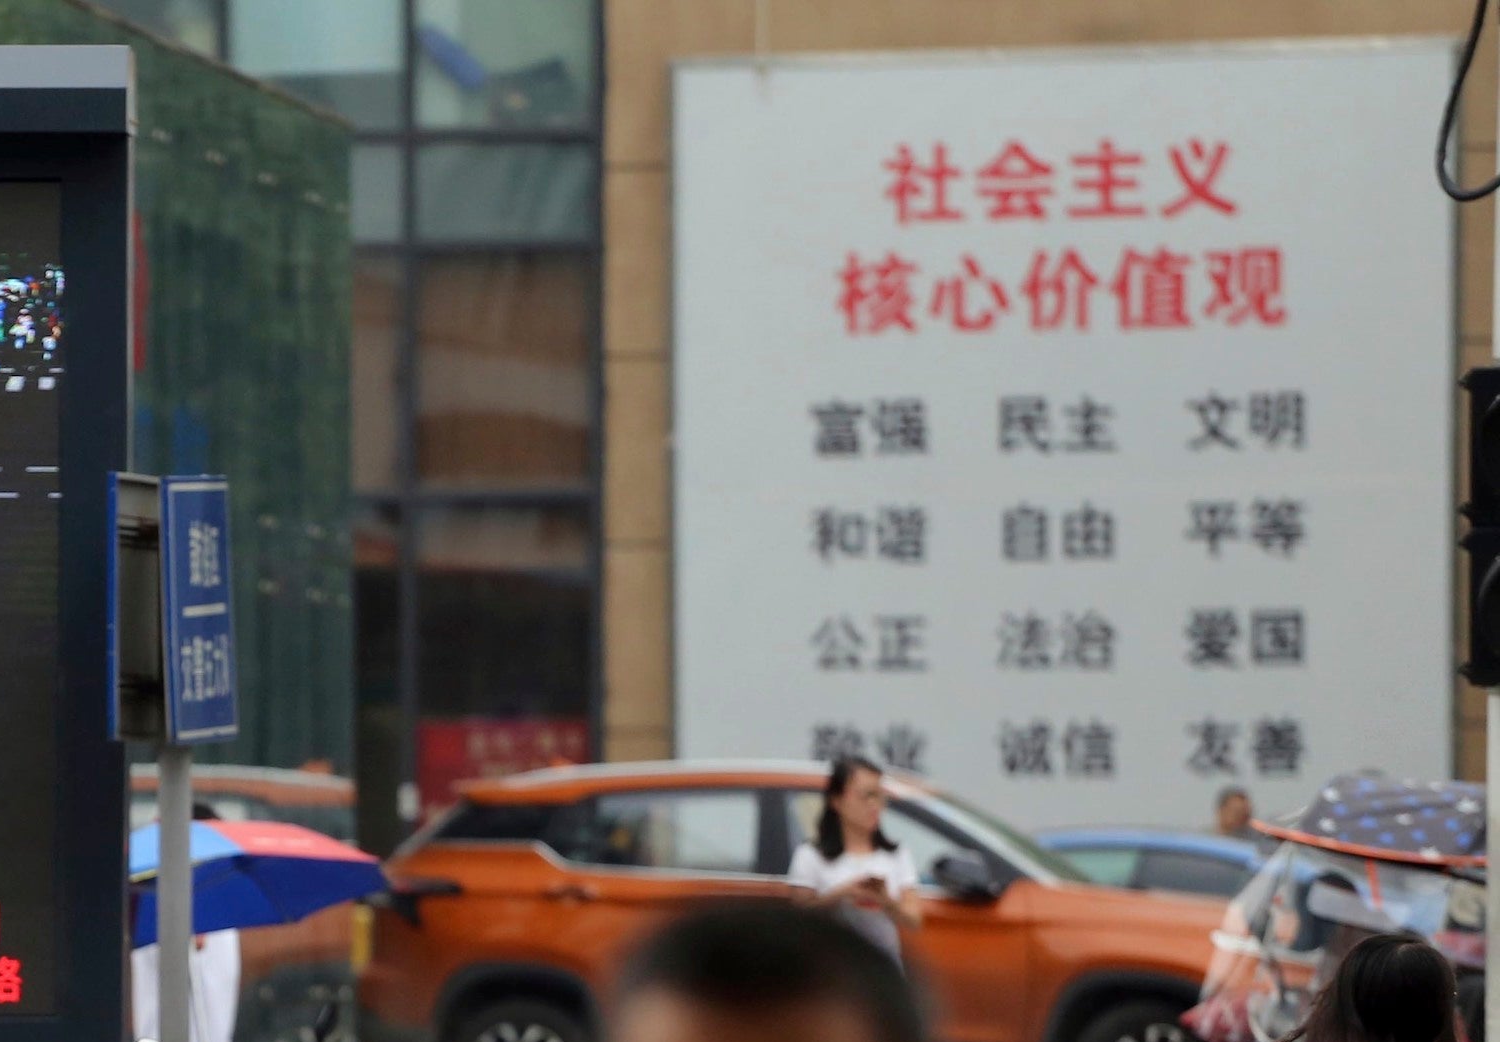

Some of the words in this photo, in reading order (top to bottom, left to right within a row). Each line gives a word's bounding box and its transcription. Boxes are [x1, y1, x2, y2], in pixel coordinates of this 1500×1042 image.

[887, 140, 1237, 224] 社会主义
[837, 247, 1286, 332] 核心价值观
[811, 400, 928, 457] 富强
[999, 397, 1114, 453] 民主
[1189, 391, 1306, 450] 文明
[816, 508, 926, 563] 和谐
[1003, 504, 1114, 561] 自由
[1187, 500, 1305, 557] 平等
[815, 618, 923, 671] 公正
[999, 614, 1115, 670] 法治
[1185, 608, 1306, 669] 爱国
[1000, 722, 1115, 778] 诚信
[1187, 718, 1306, 778] 友善
